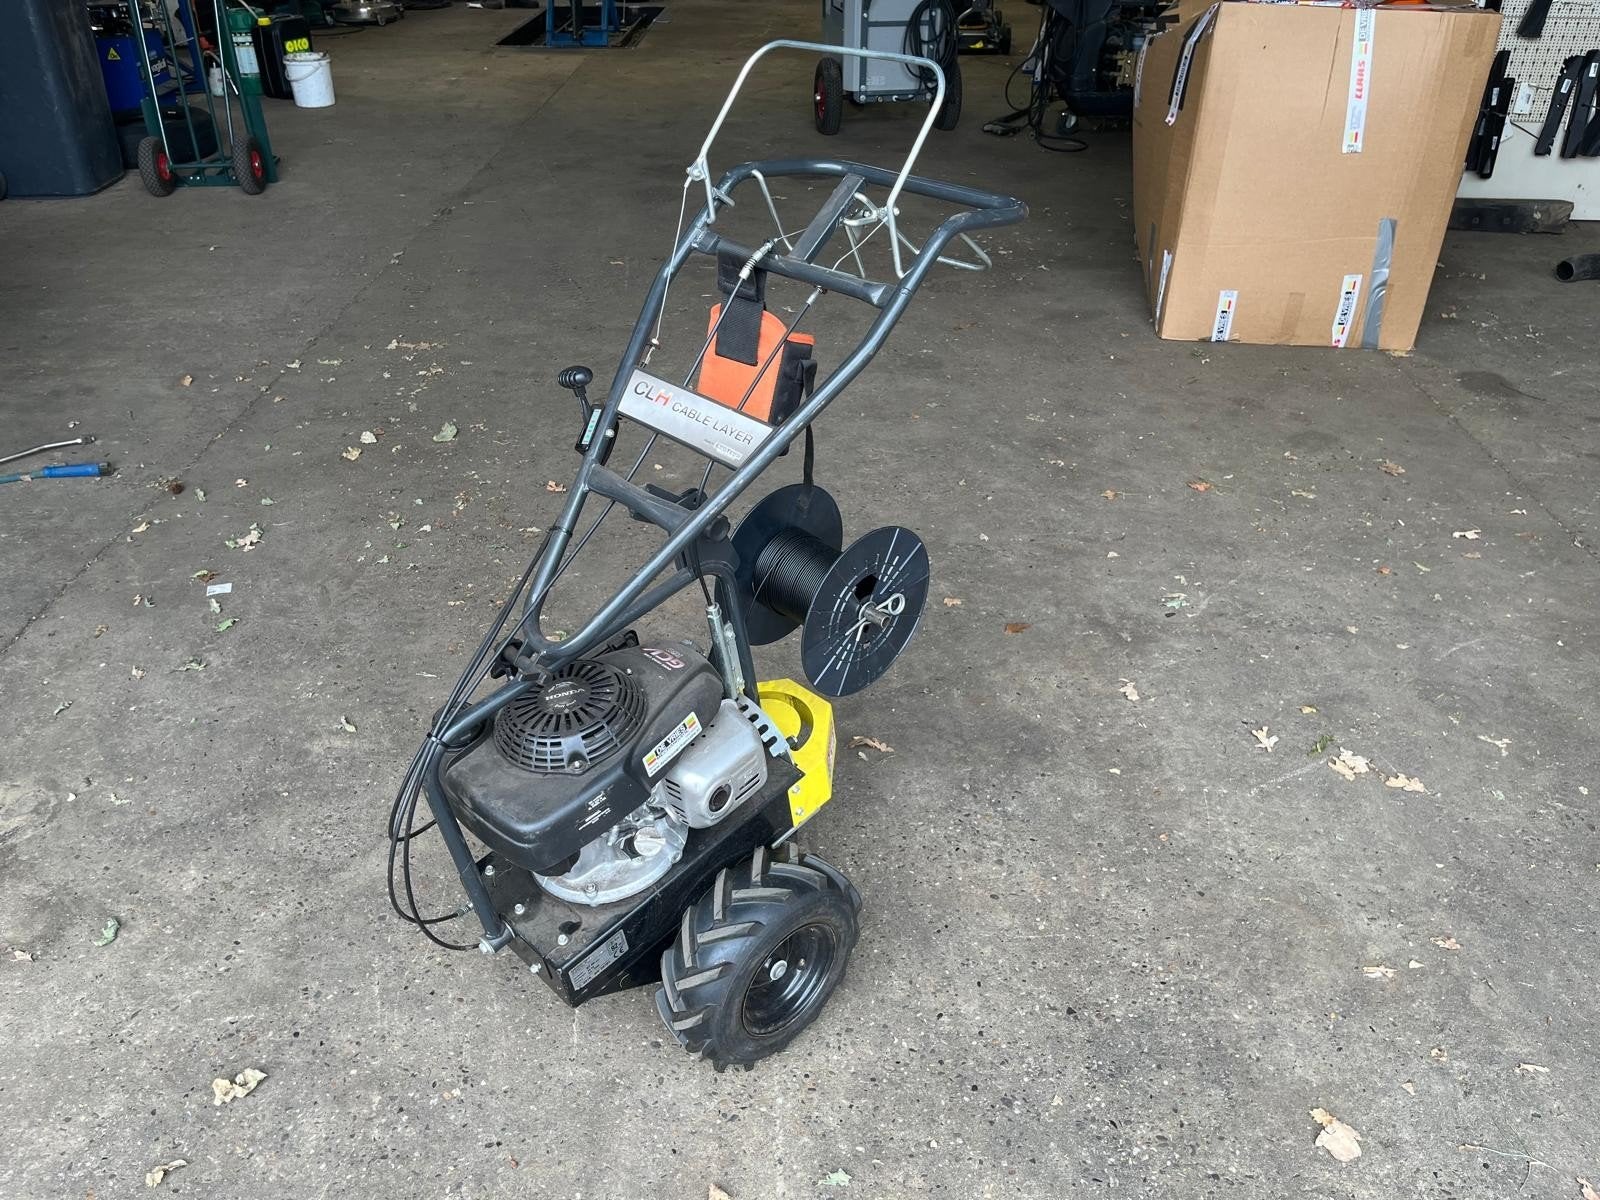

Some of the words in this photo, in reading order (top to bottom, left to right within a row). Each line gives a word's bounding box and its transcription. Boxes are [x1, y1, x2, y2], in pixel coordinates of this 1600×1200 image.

[1355, 60, 1365, 98] CLAAS
[634, 381, 672, 406] CLH
[671, 402, 712, 426] CABLE
[714, 421, 753, 445] LAYER
[545, 688, 585, 700] HONDA
